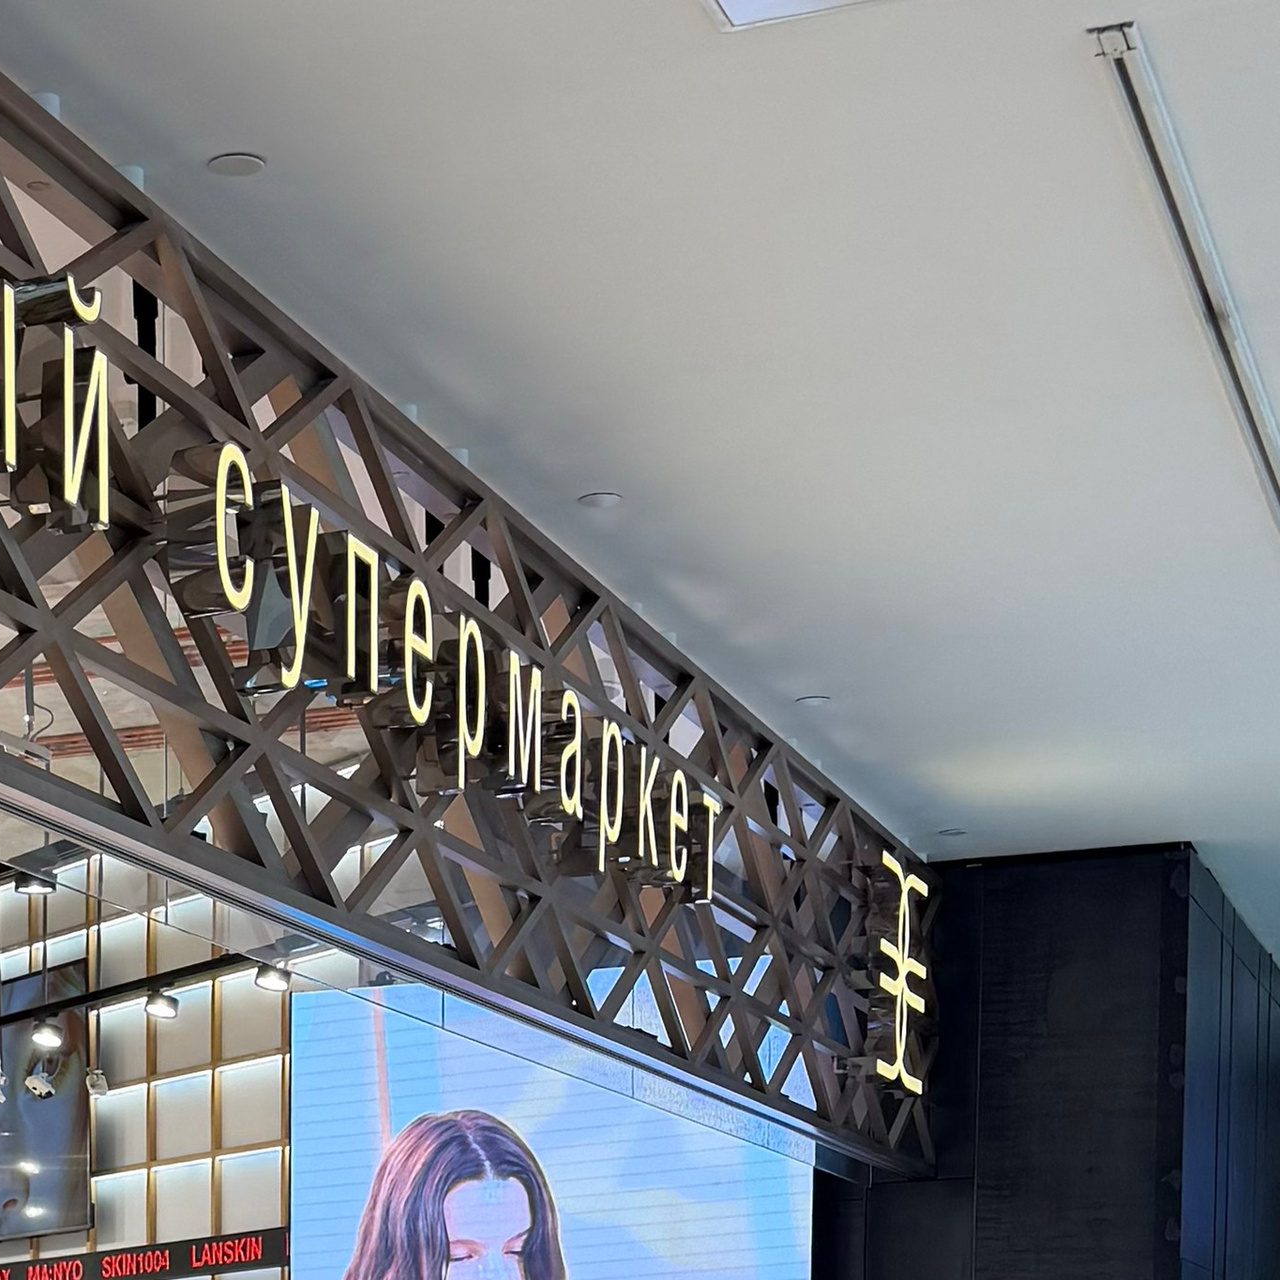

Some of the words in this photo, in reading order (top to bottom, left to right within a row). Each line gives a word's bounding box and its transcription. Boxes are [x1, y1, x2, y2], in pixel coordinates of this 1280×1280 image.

[216, 442, 721, 900] супермаркет
[101, 1249, 171, 1279] SKIN1004
[190, 1236, 263, 1269] LANSKIN
